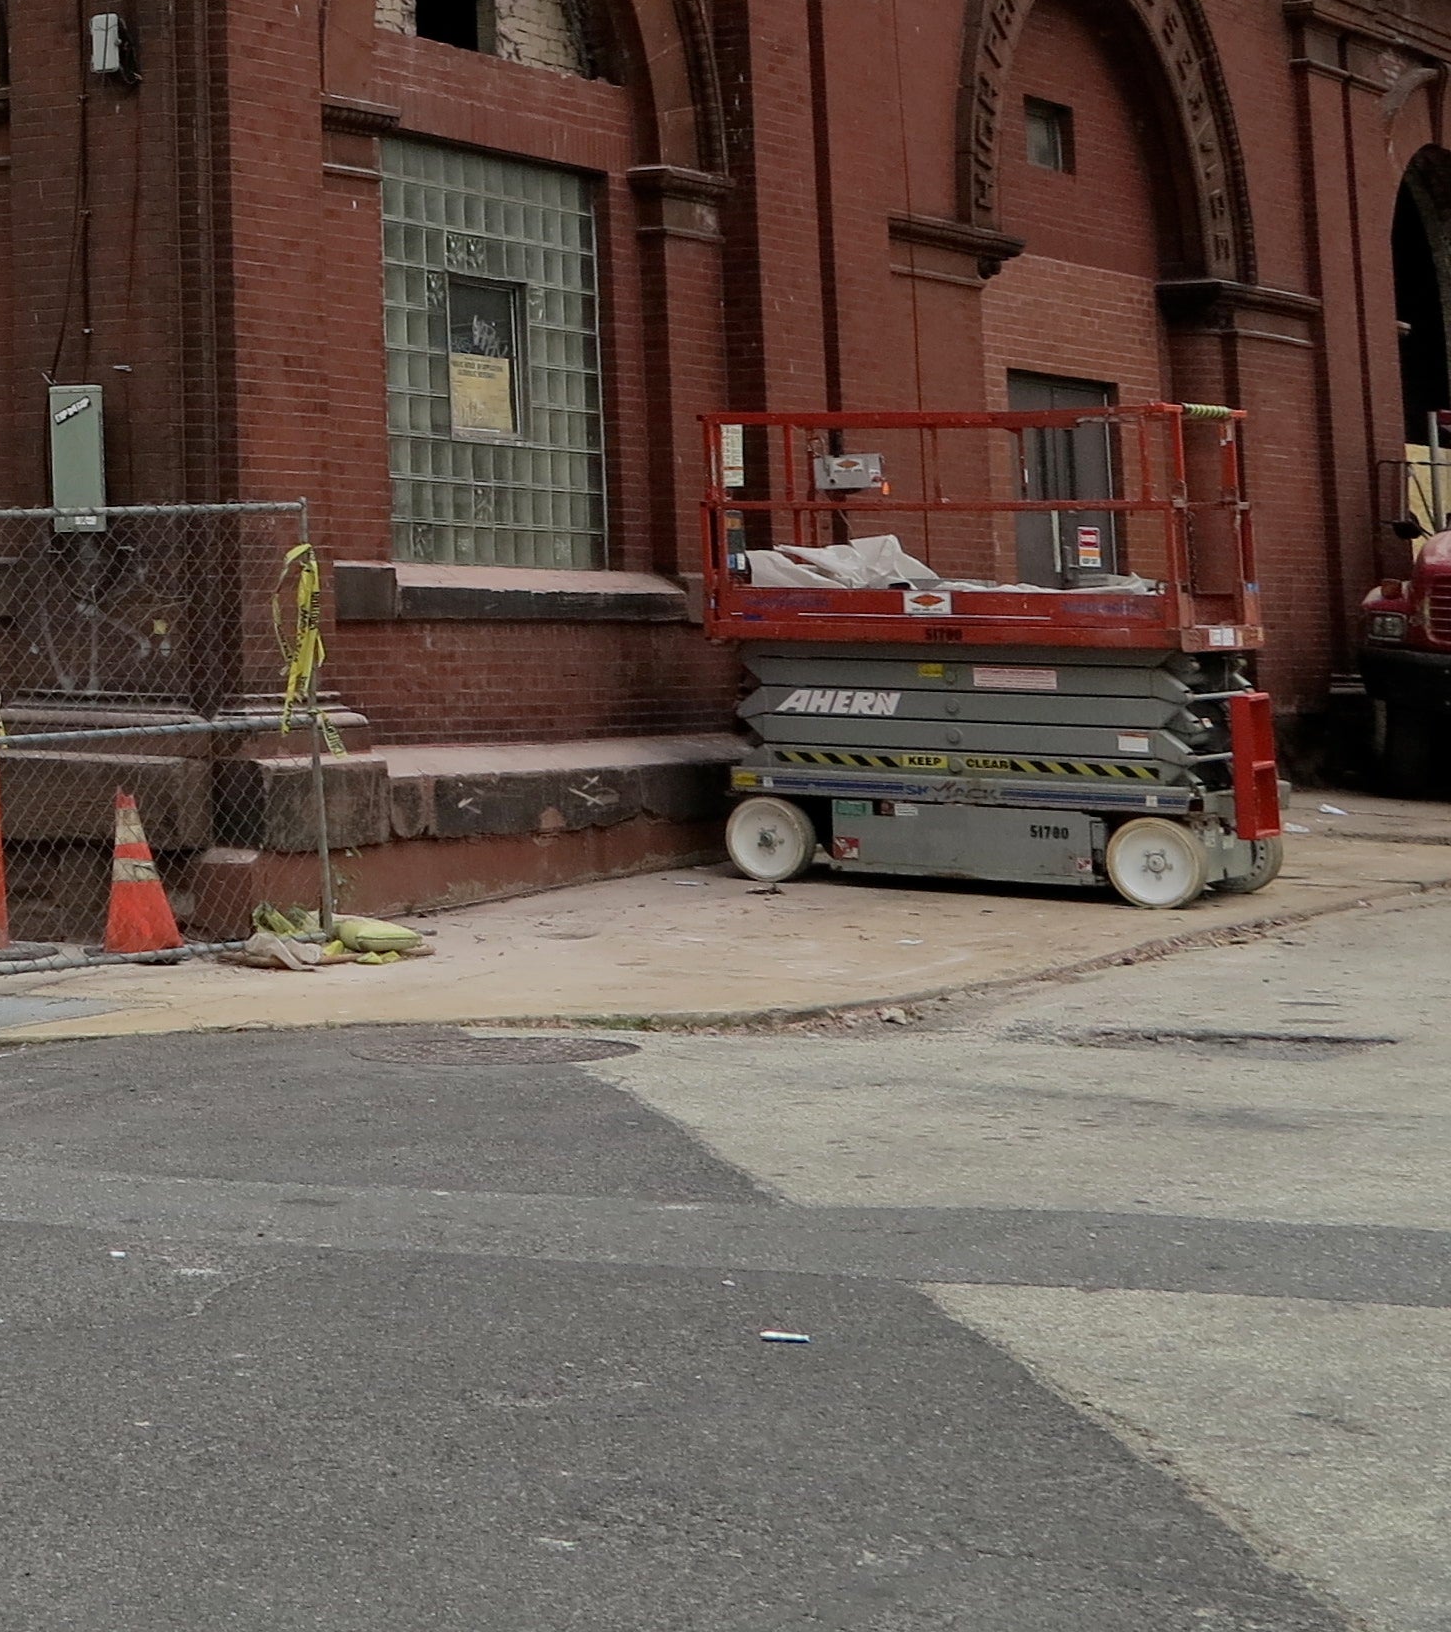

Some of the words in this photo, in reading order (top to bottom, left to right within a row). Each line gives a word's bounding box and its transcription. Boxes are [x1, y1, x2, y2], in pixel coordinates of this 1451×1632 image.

[775, 689, 902, 716] AHERN
[908, 756, 942, 767] KEEP
[965, 757, 1009, 770] CLEAR
[1029, 824, 1070, 840] 51780
